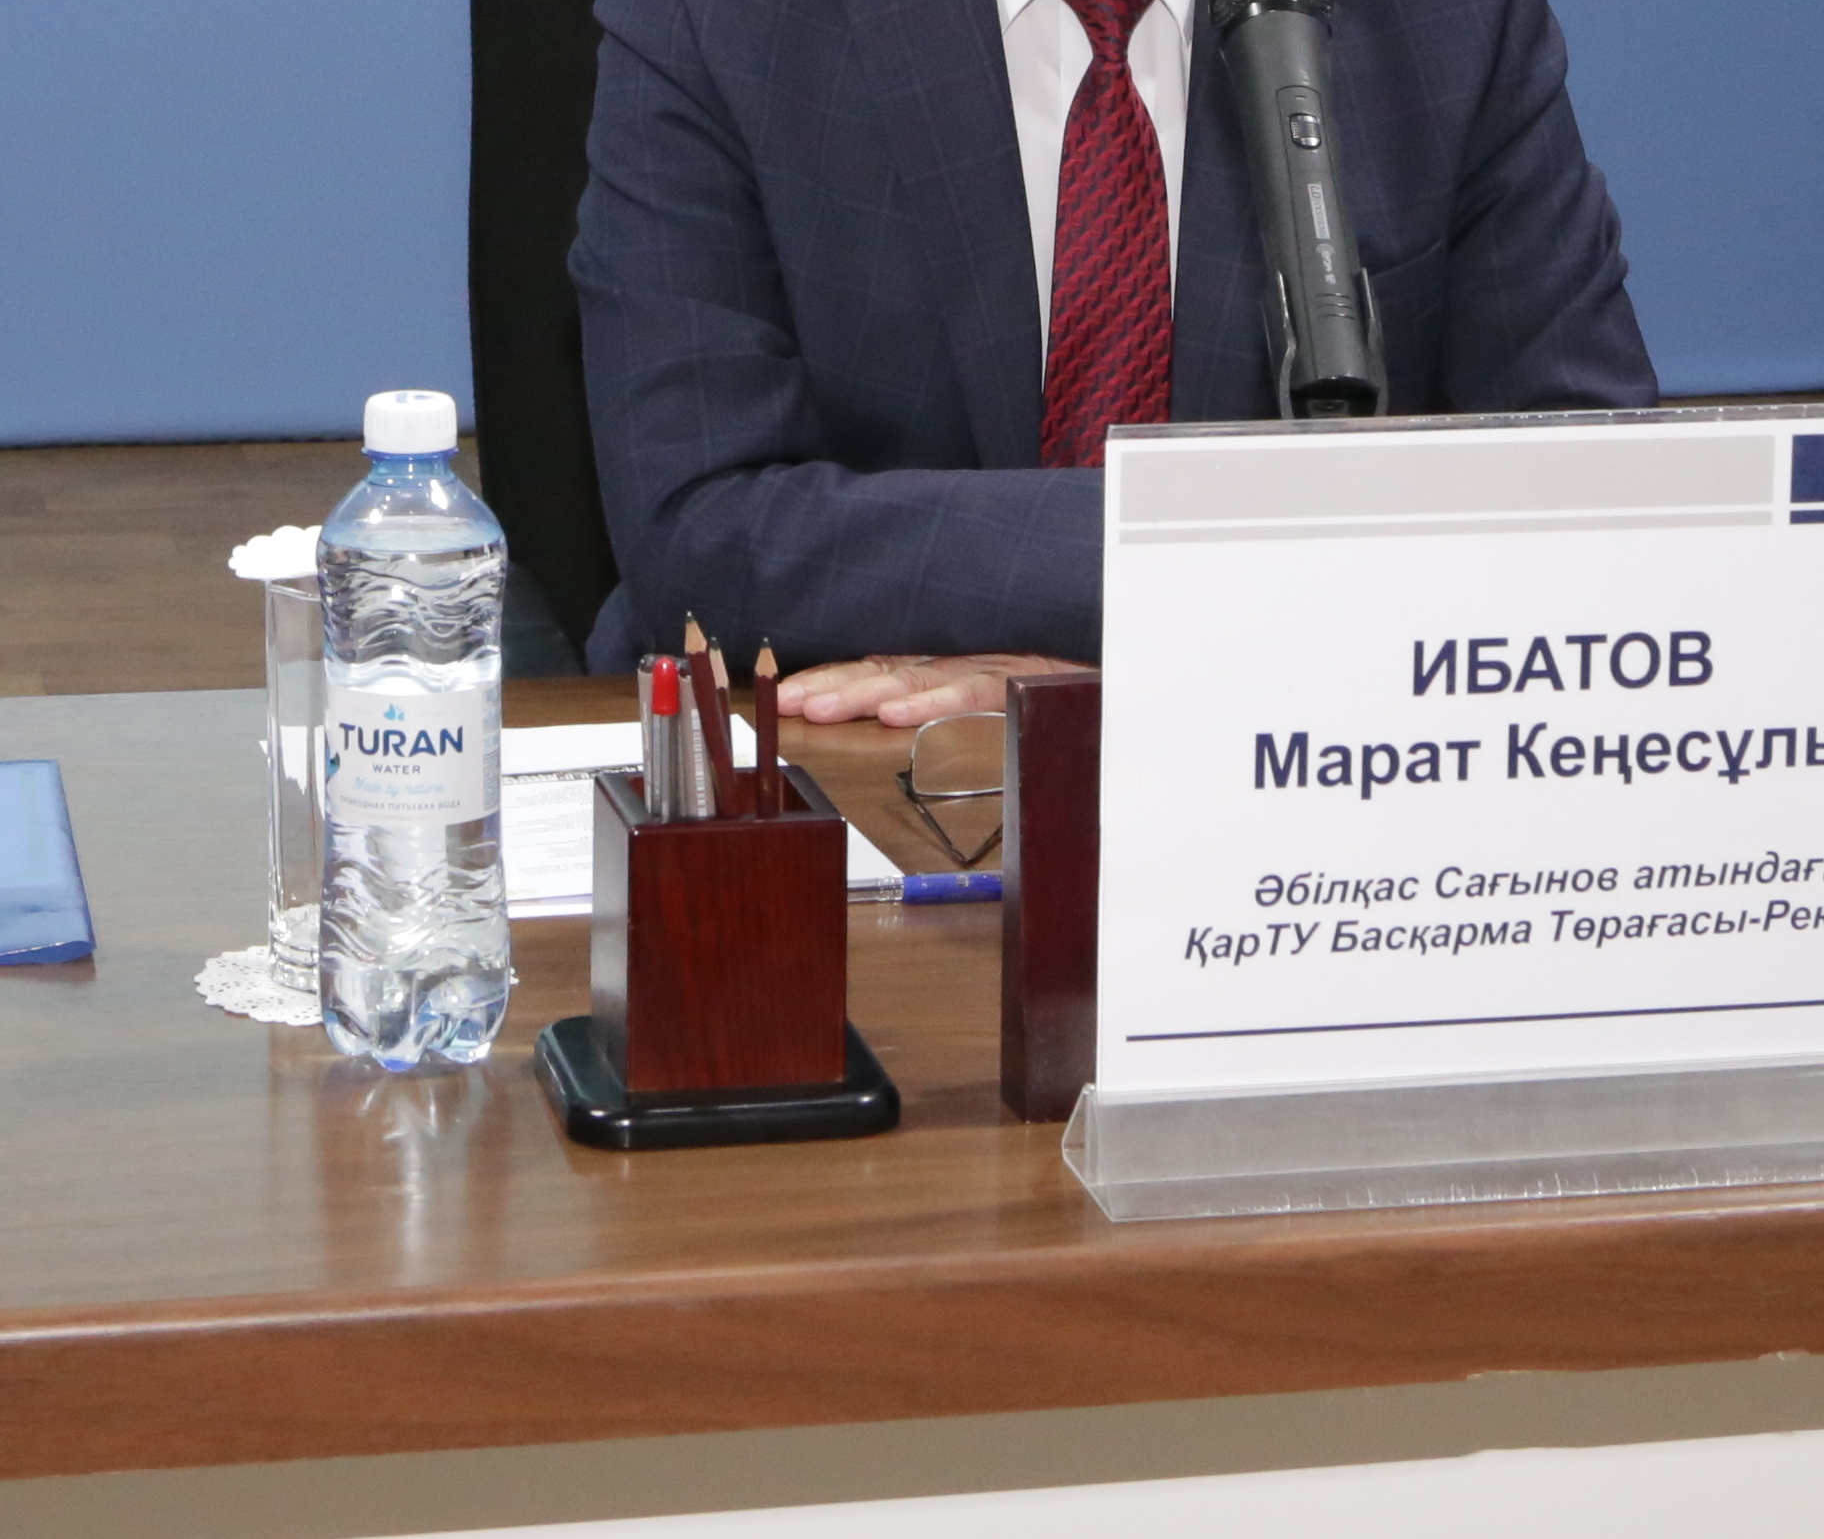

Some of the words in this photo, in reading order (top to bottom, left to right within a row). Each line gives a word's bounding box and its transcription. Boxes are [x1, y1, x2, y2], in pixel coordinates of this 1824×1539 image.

[1413, 630, 1713, 696] ИБАТОВ
[339, 722, 464, 758] TURAN
[372, 763, 421, 775] WATER
[1254, 731, 1481, 800] Марат
[438, 799, 462, 810] ВОДА
[1255, 871, 1419, 909] Әбілқас
[1435, 866, 1618, 899] Сағынов
[1185, 922, 1319, 967] ҚарТУ
[1331, 920, 1532, 955] Басқарма
